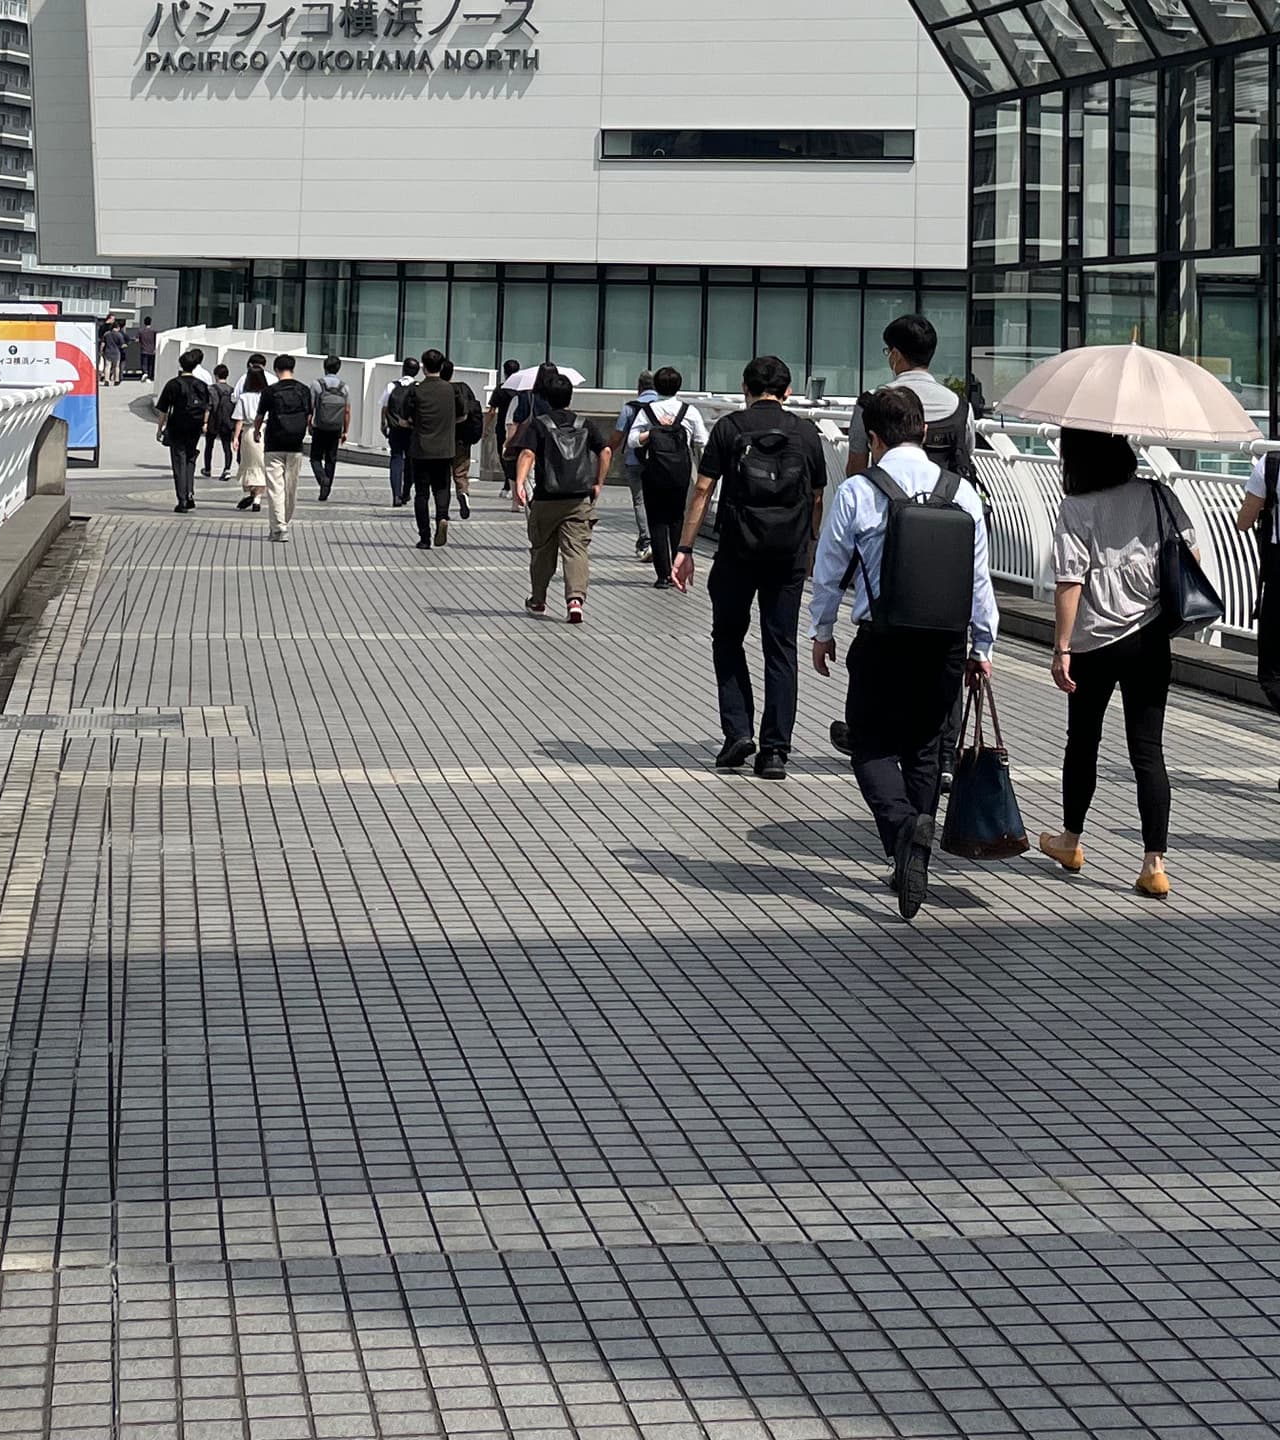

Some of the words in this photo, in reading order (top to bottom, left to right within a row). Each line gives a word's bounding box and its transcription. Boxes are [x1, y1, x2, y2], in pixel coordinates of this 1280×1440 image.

[145, 50, 269, 72] PACIFICO
[280, 49, 434, 72] YOKOHAMA
[444, 48, 539, 70] NORTH
